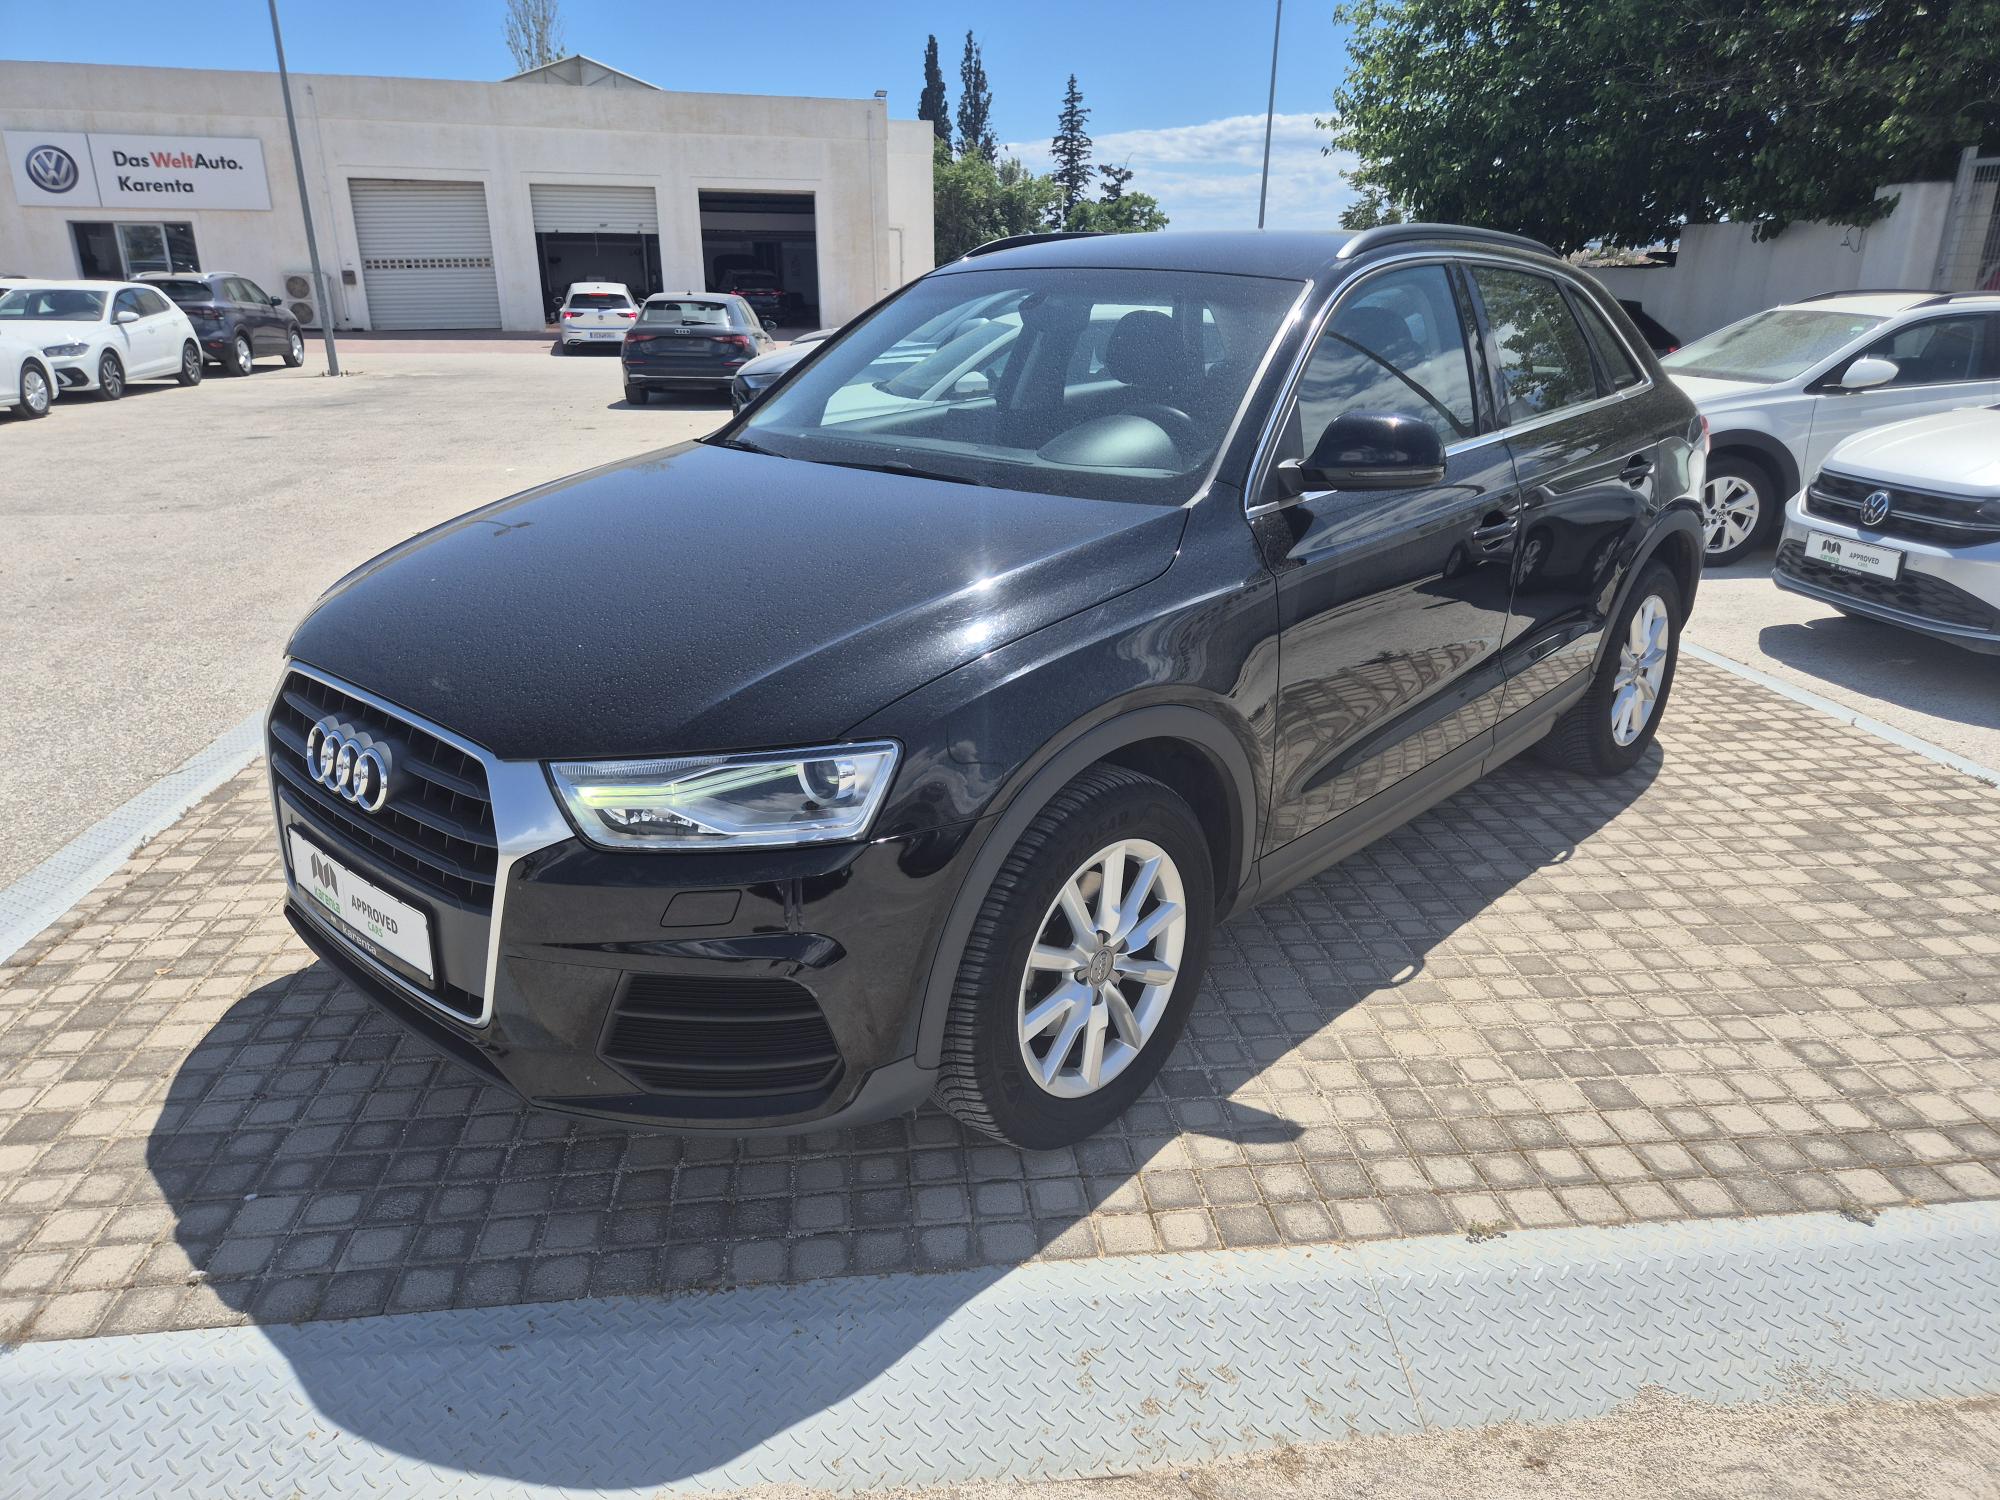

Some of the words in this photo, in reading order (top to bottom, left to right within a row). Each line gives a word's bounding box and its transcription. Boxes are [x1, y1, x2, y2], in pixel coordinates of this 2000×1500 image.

[118, 176, 194, 193] Karenta
[1849, 552, 1880, 565] APPROVED
[351, 894, 398, 934] APPROVED
[367, 921, 383, 938] CARS
[342, 923, 377, 956] karenta
